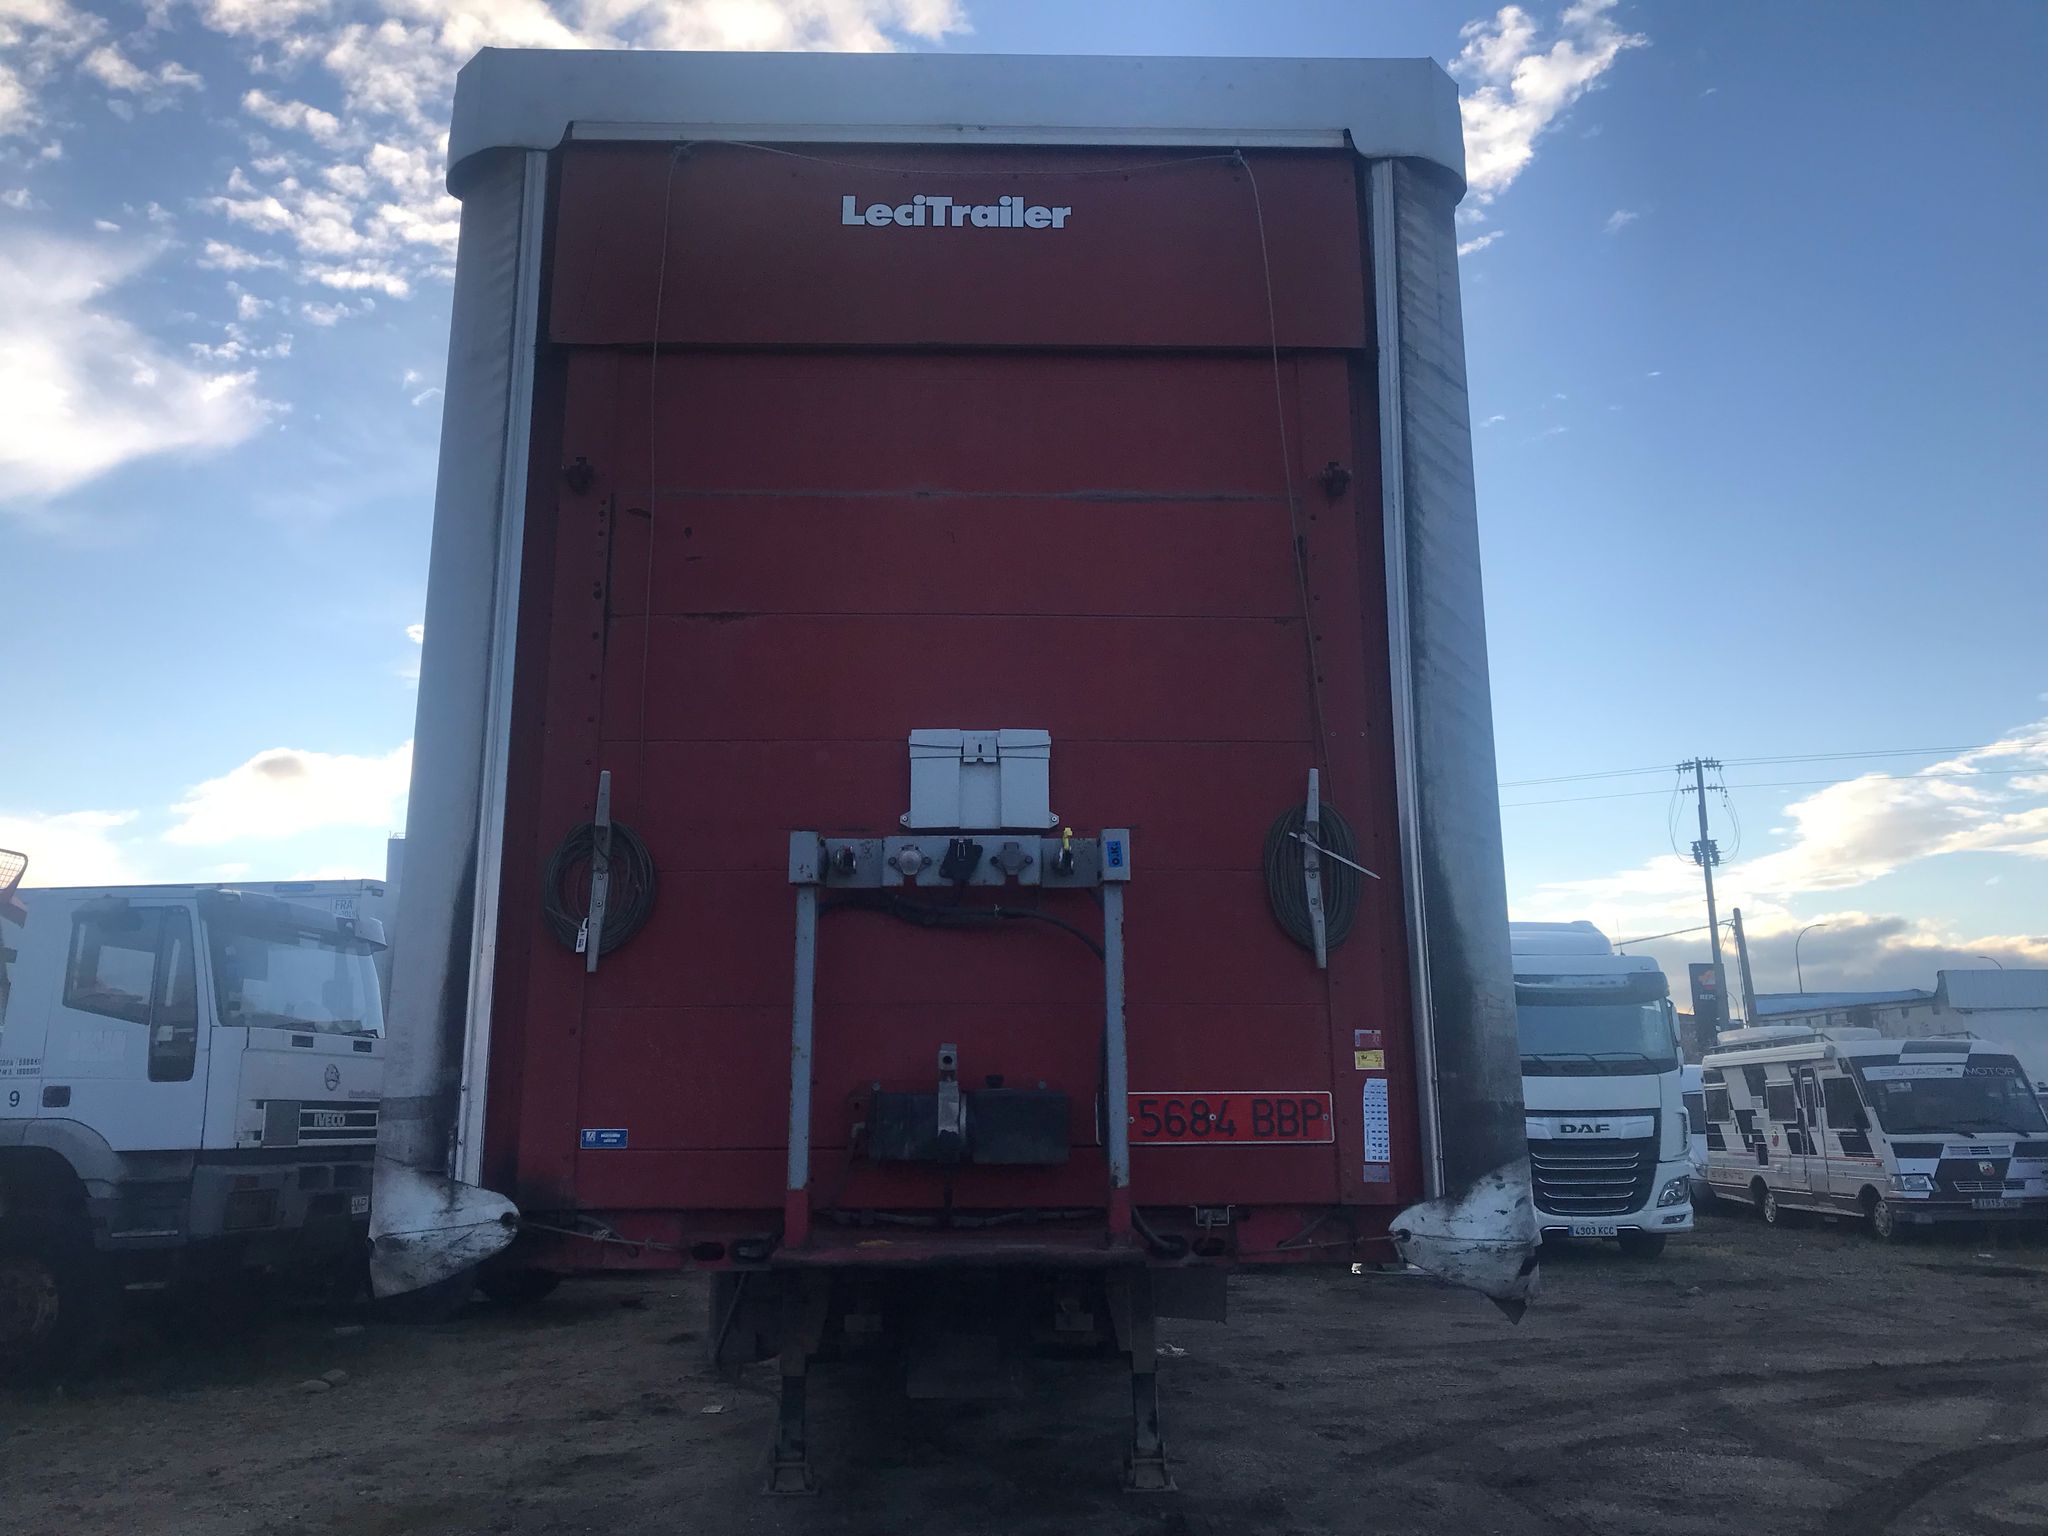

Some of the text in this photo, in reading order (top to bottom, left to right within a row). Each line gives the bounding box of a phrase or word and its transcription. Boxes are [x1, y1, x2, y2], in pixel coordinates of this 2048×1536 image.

[842, 194, 1072, 229] LeciTrailer
[335, 899, 353, 910] FRA
[1965, 1066, 2016, 1076] MOTOR
[9, 1090, 20, 1107] 9
[313, 1112, 346, 1127] IVECO
[1138, 1099, 1237, 1138] 5684
[1251, 1098, 1323, 1138] BBP
[1560, 1124, 1610, 1134] DAF
